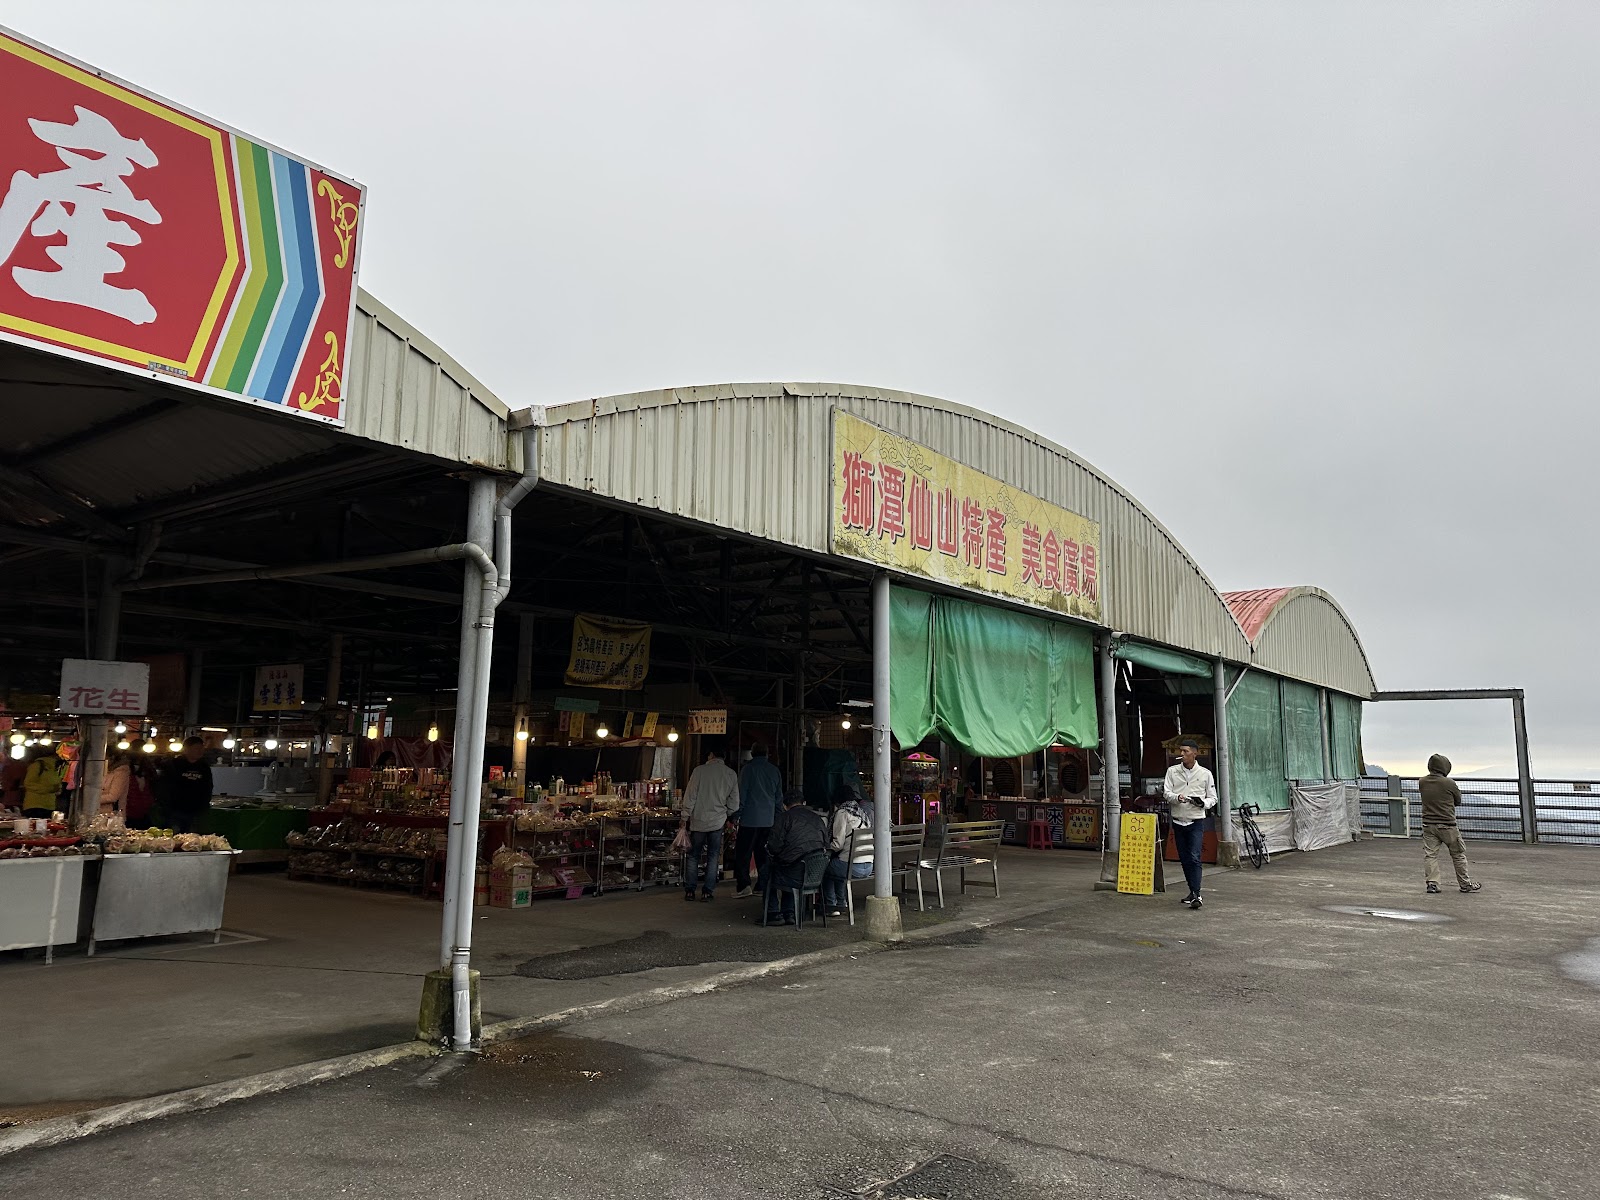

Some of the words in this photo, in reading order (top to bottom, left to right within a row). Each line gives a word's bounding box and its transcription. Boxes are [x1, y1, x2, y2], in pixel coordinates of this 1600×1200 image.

[841, 449, 1007, 577] 獅潭仙山特產
[1021, 520, 1099, 604] 美食廣場
[67, 686, 141, 712] 花生
[982, 803, 998, 820] 來
